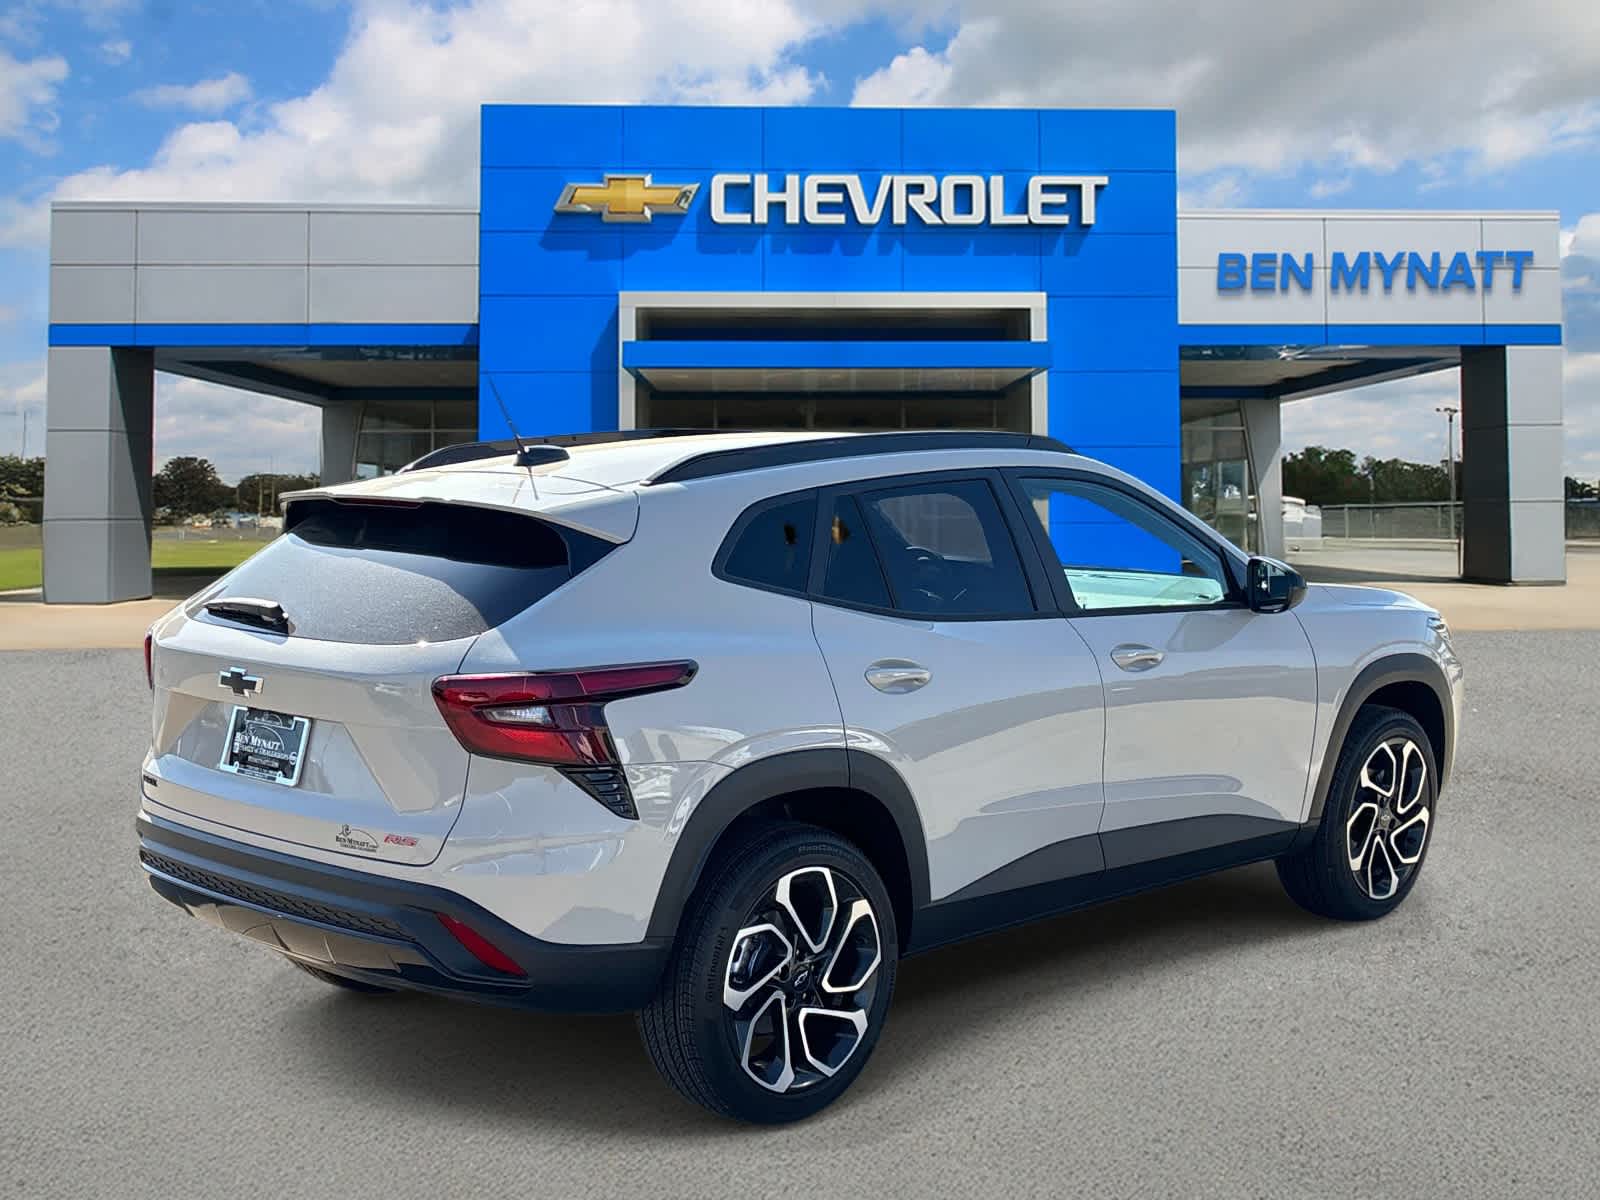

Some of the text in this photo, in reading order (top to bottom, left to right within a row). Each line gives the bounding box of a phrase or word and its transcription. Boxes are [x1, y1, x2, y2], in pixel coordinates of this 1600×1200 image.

[710, 173, 1109, 225] CHEVROLET
[1217, 250, 1534, 292] BEN MYNATT
